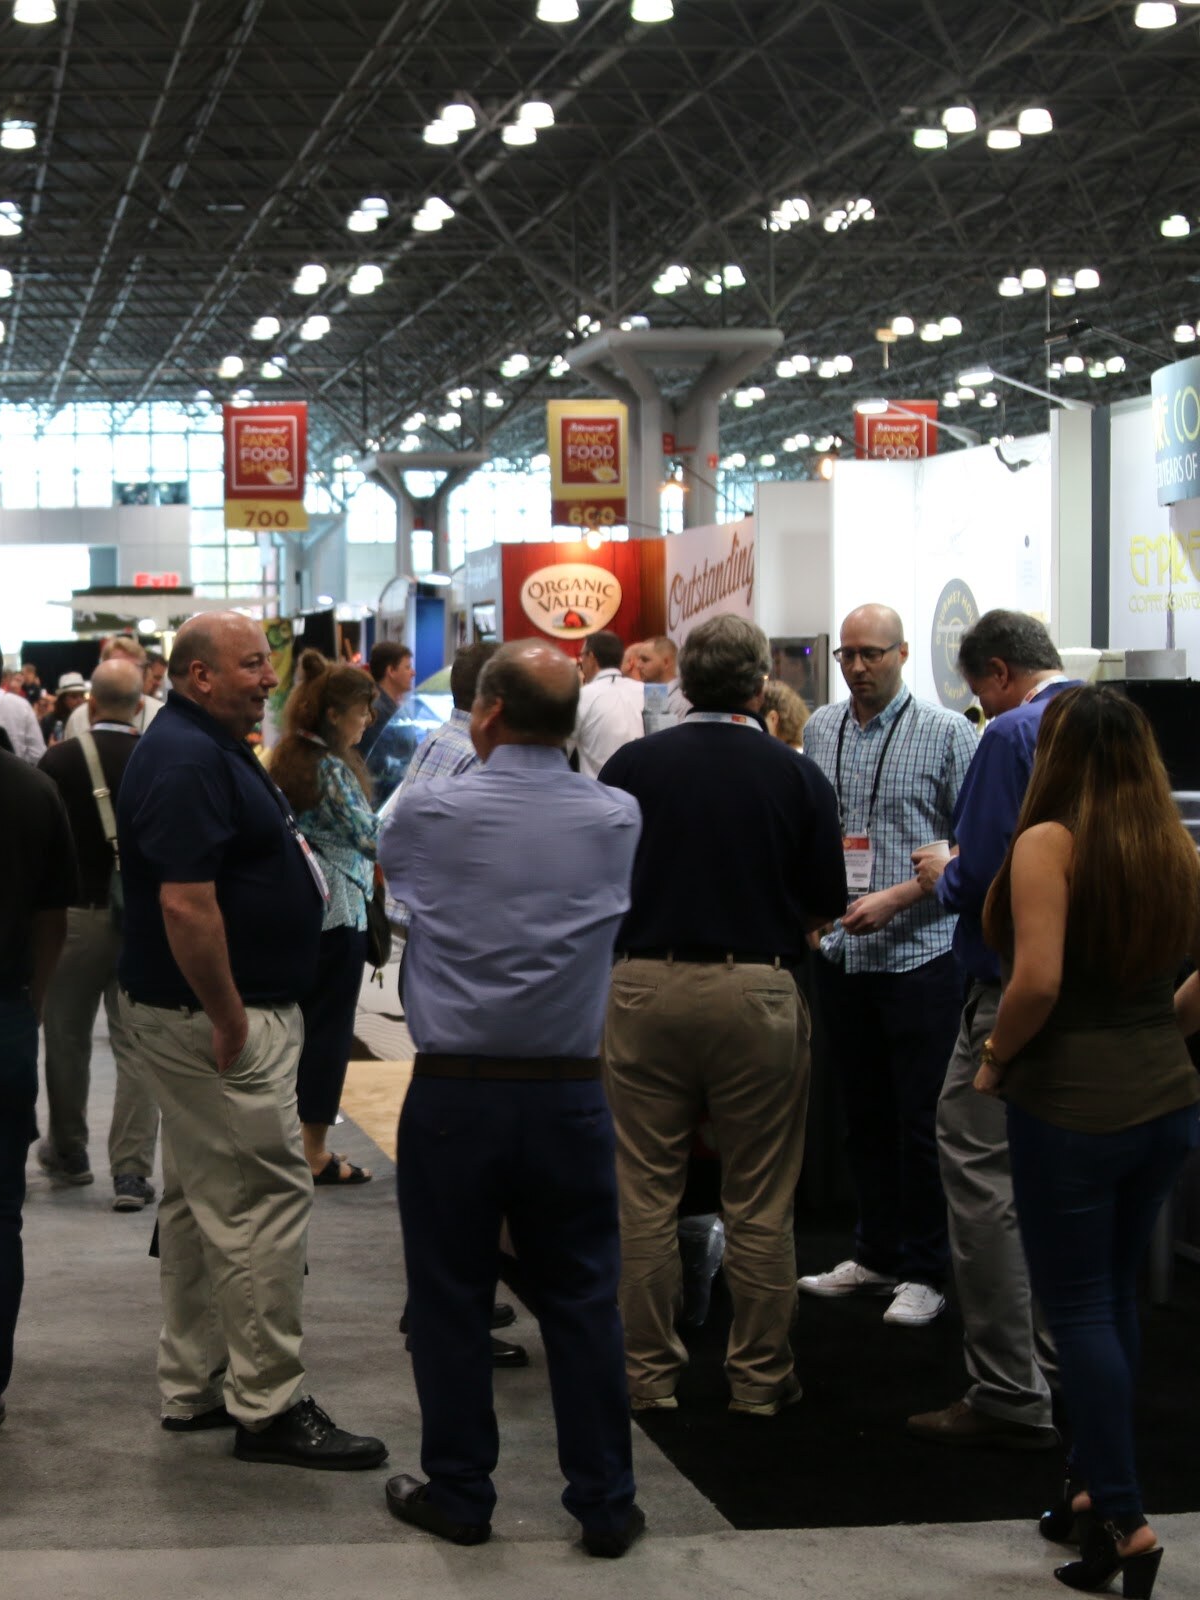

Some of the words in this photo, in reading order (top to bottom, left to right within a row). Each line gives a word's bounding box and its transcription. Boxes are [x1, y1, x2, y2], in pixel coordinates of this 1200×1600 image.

[1174, 386, 1200, 443] CO
[241, 434, 289, 447] FANCY
[568, 432, 614, 445] FANCY
[873, 432, 919, 446] FANCY
[241, 447, 289, 461] FOOD
[568, 445, 614, 459] FOOD
[874, 445, 919, 459] FOOD
[241, 461, 289, 475] SHOW
[568, 459, 614, 472] SHOW
[1162, 456, 1184, 485] YEARS
[1185, 452, 1198, 482] OF
[244, 510, 289, 527] 700
[569, 506, 616, 524] 600
[135, 572, 179, 588] Exit
[668, 531, 755, 632] Outstanding
[527, 577, 615, 600] ORGANIC
[537, 596, 607, 613] VALLEY
